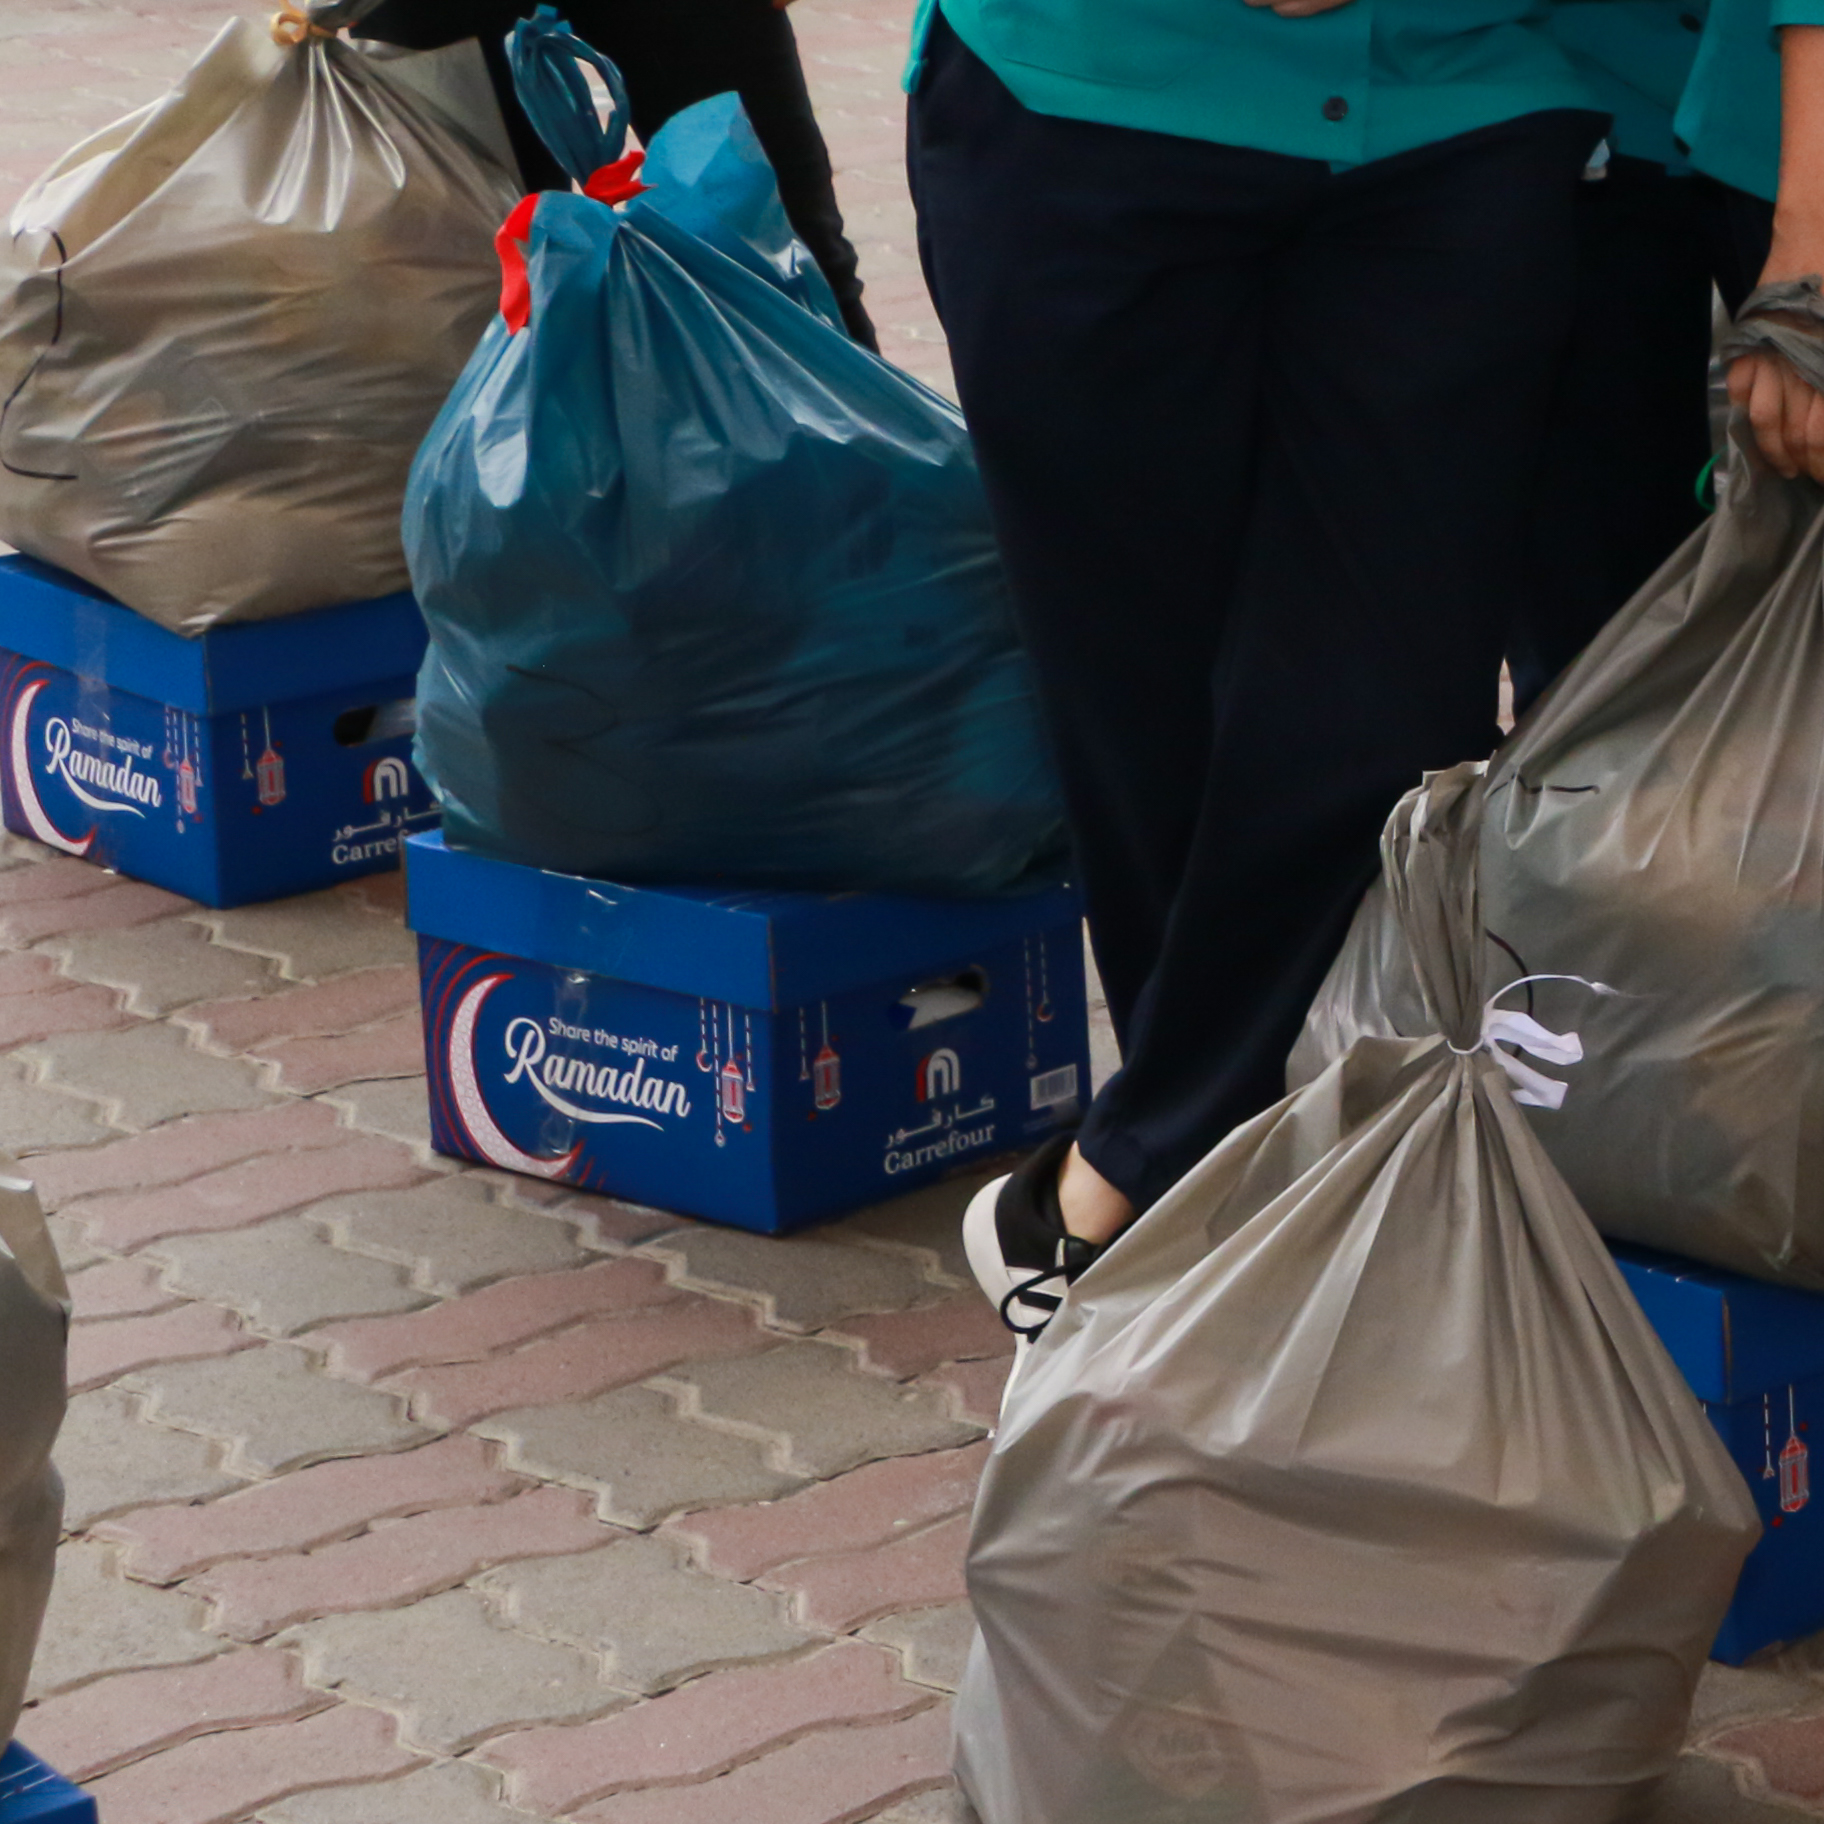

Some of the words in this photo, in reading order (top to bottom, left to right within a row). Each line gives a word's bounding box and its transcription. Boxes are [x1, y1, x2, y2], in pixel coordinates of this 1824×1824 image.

[45, 717, 162, 819] Ramadan
[332, 829, 409, 865] Carref
[549, 1016, 591, 1043] Share
[594, 1028, 619, 1049] the
[621, 1037, 659, 1058] spirit
[661, 1044, 679, 1062] of
[504, 1017, 691, 1132] Ramadan
[883, 1125, 996, 1175] Carrefour
